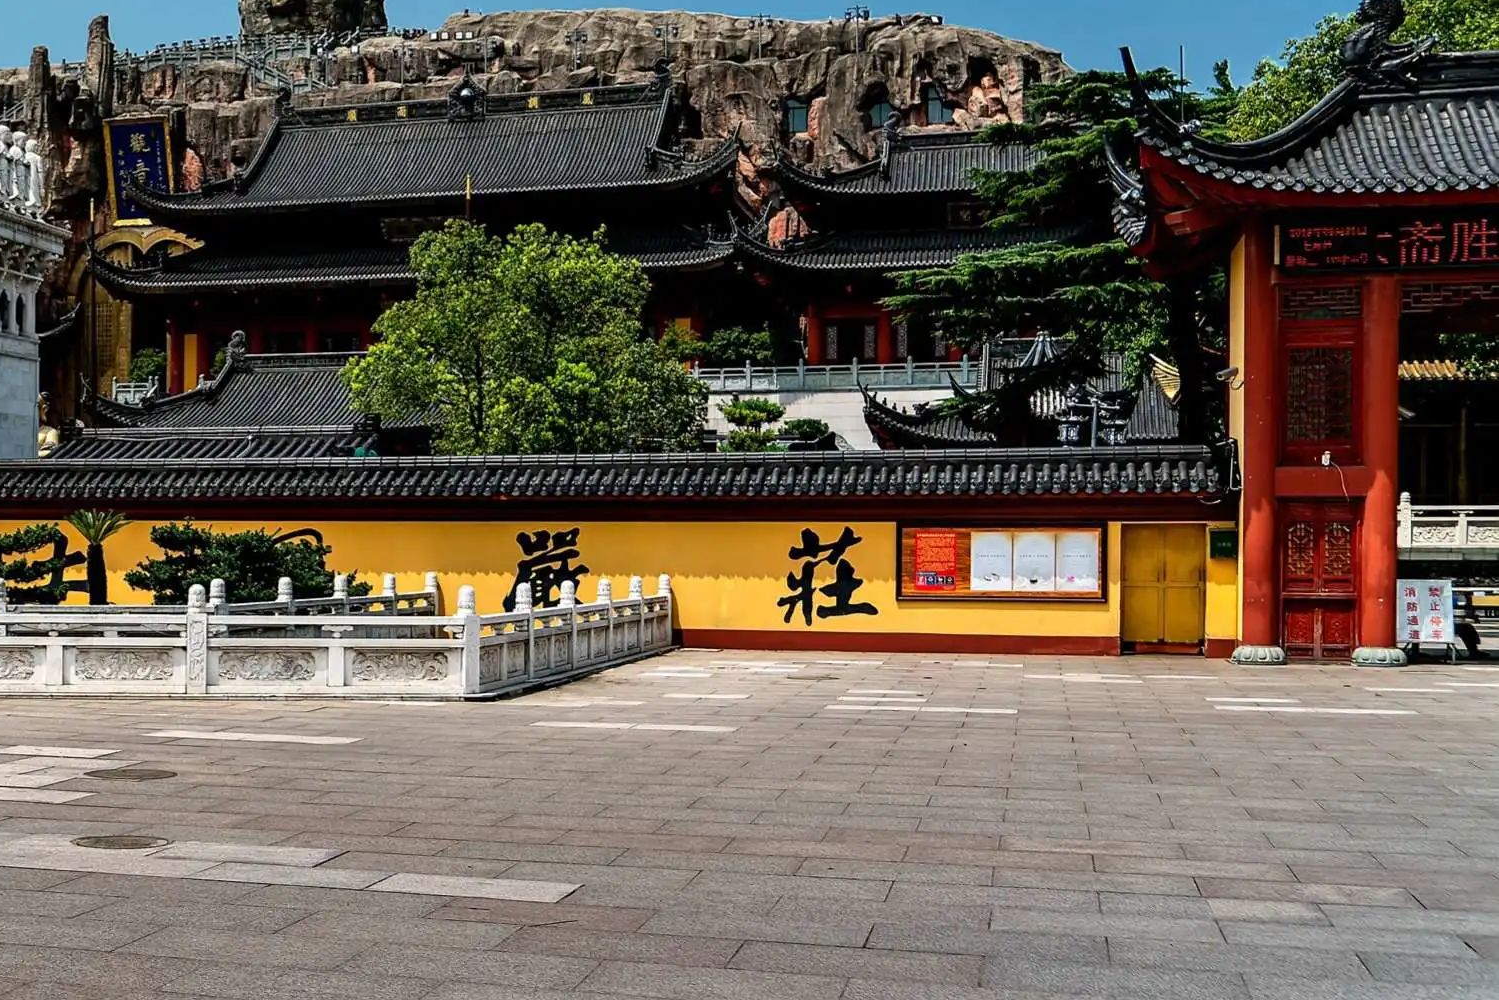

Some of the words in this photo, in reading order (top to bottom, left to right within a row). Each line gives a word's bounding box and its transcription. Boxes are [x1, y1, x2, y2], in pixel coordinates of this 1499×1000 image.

[502, 526, 591, 613] 嚴
[776, 525, 879, 627] 莊
[1403, 586, 1420, 640] 消防通道
